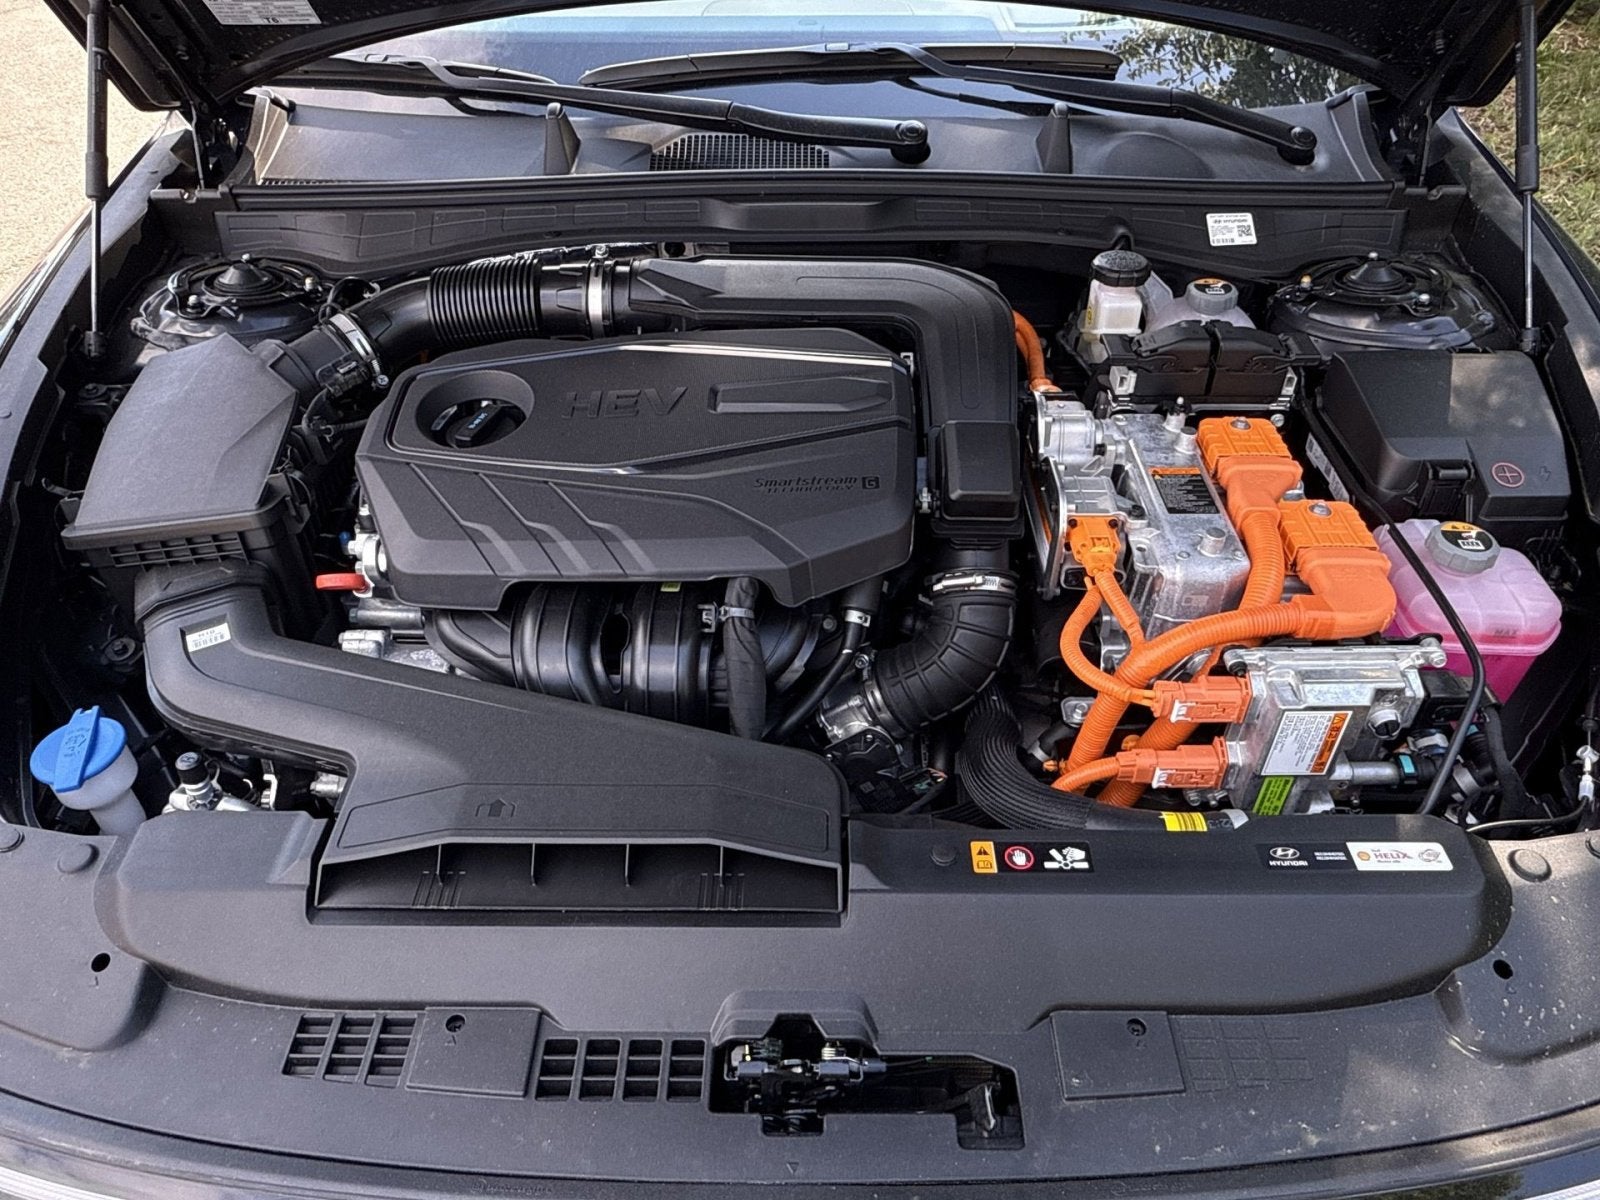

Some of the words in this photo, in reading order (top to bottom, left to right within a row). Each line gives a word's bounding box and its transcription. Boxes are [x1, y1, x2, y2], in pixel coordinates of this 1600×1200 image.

[561, 386, 688, 418] HEV
[753, 476, 858, 488] Smartstream
[862, 476, 880, 489] G
[1374, 852, 1409, 860] HELIX
